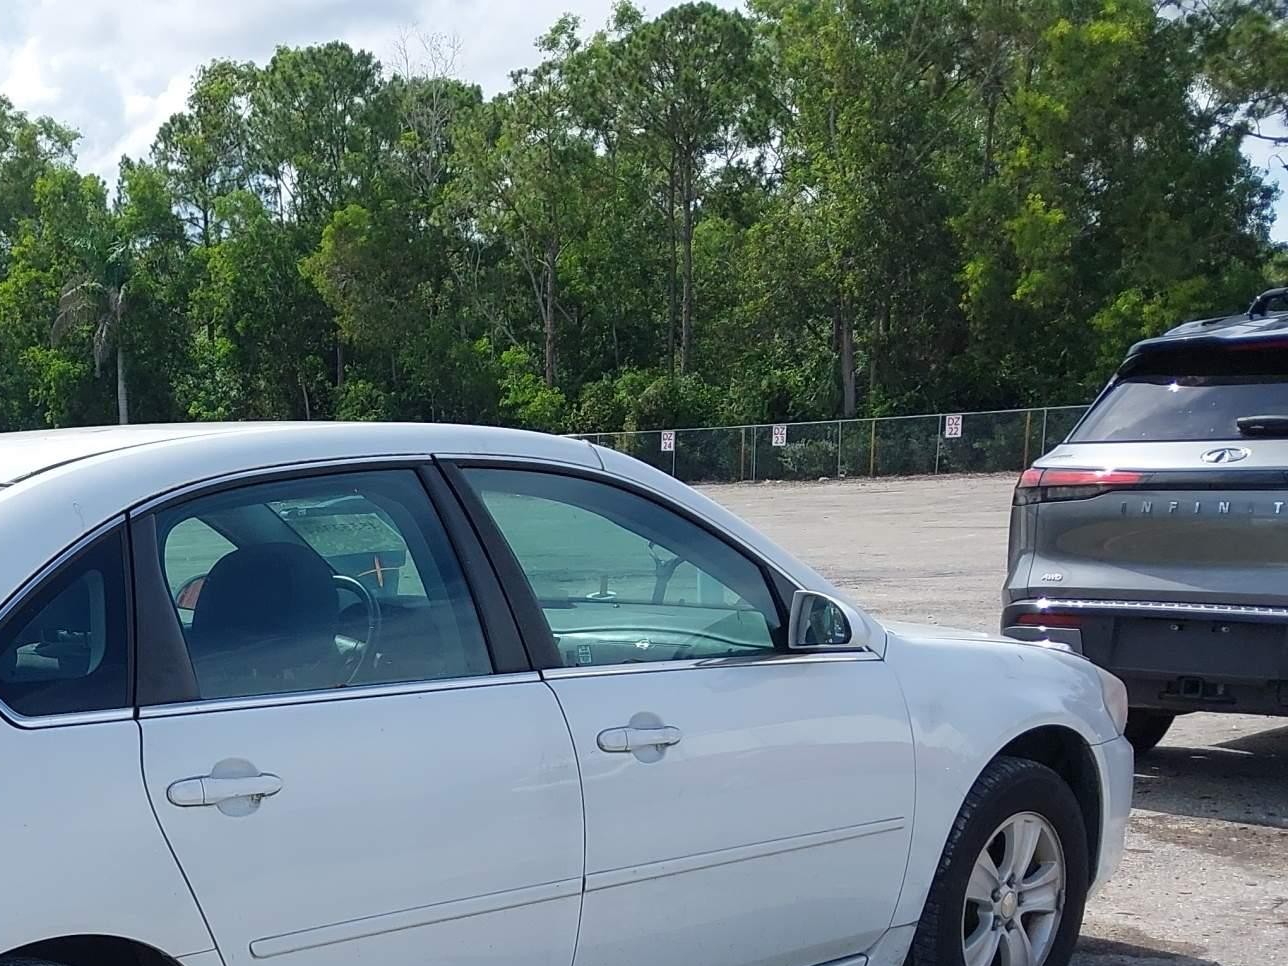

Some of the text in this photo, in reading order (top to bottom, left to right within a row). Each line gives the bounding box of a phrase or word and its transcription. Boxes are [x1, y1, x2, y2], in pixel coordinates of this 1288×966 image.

[947, 417, 961, 426] DZ
[773, 426, 785, 435] DZ
[948, 427, 959, 436] 22
[662, 432, 673, 441] DZ
[774, 436, 785, 445] 23
[663, 441, 672, 449] 24
